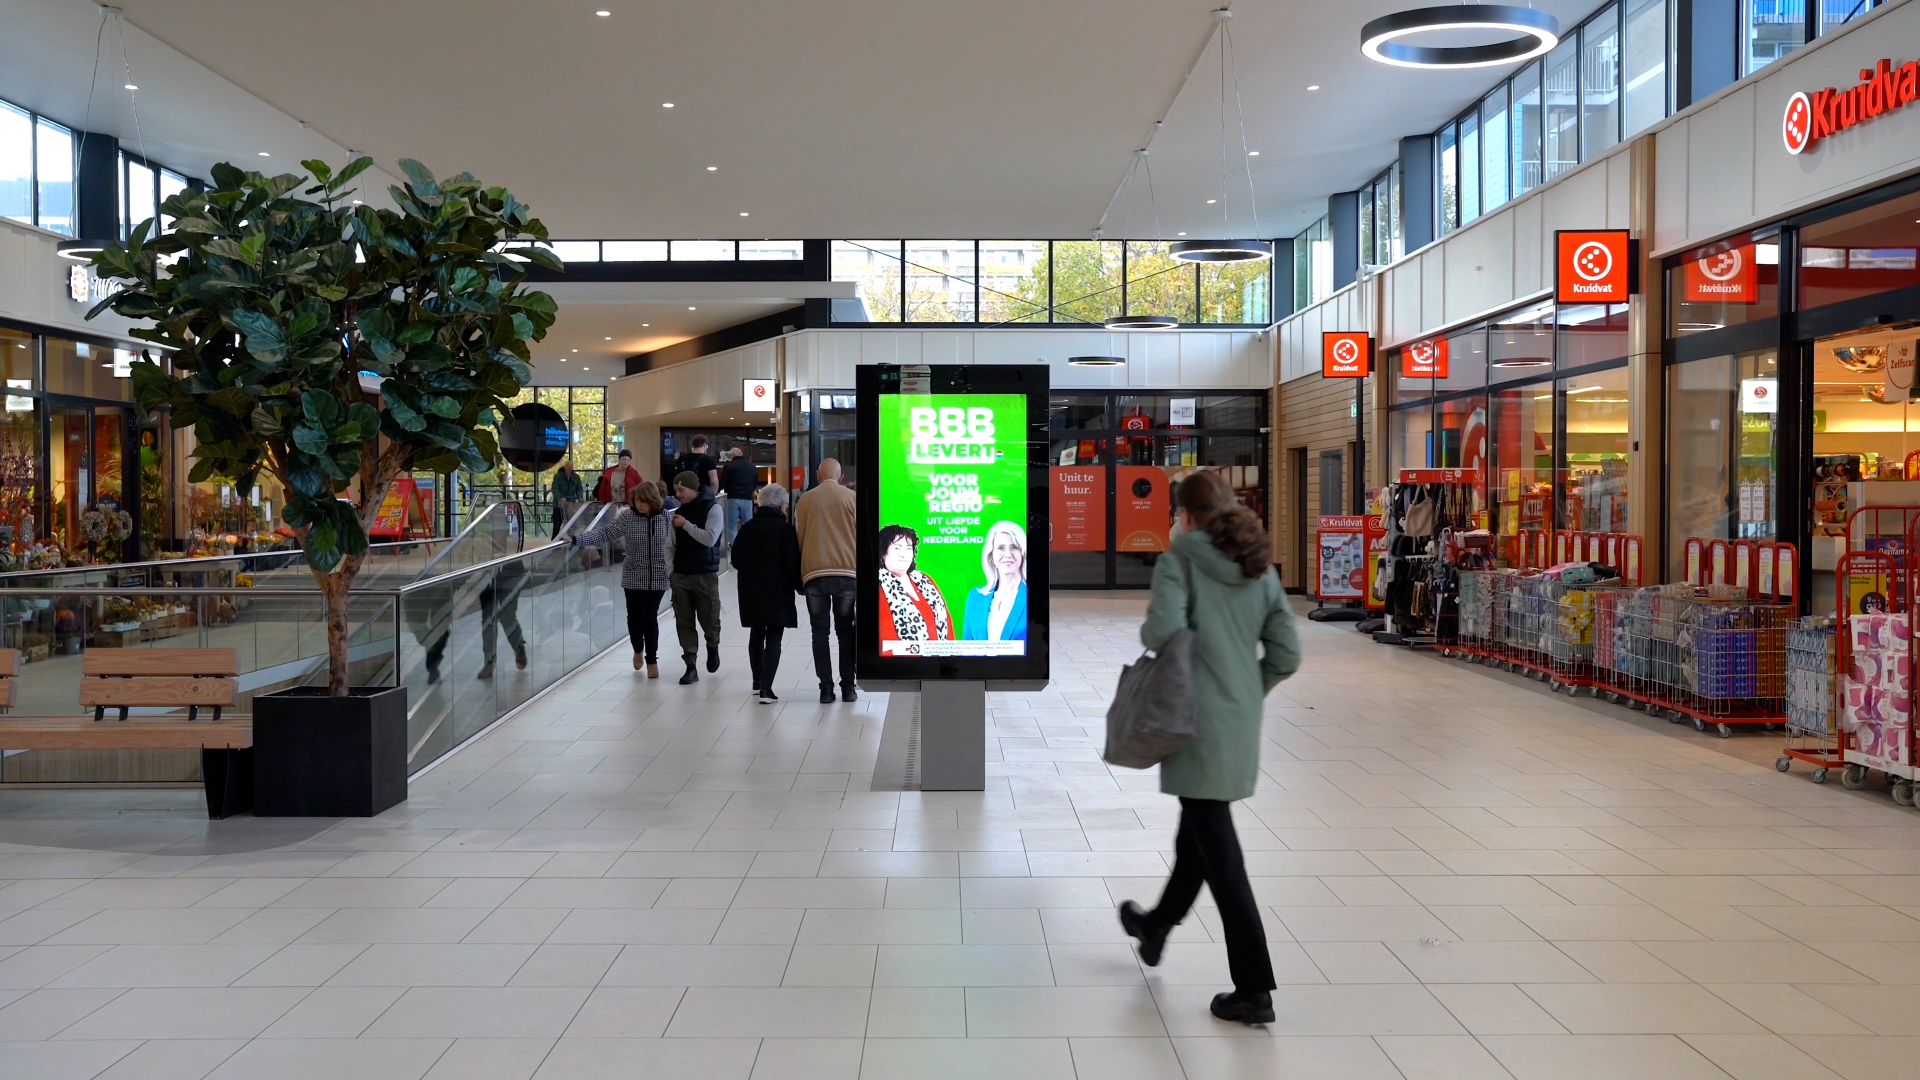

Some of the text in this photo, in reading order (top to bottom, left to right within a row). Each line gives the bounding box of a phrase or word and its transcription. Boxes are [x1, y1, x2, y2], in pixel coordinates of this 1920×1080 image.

[1813, 57, 1920, 139] Kruidva
[1573, 283, 1612, 293] Kruidvat
[910, 406, 995, 439] BBB
[915, 443, 995, 458] LEVERT
[929, 474, 978, 486] VOOR
[1059, 472, 1094, 482] Unit te
[927, 487, 980, 500] JOUW
[1064, 485, 1092, 494] huur.
[929, 500, 983, 513] REGIO
[927, 516, 980, 525] UIT LIEFDE
[1329, 519, 1363, 527] Kruidvat
[939, 526, 968, 535] VOOR
[923, 535, 984, 544] NEDERLAND
